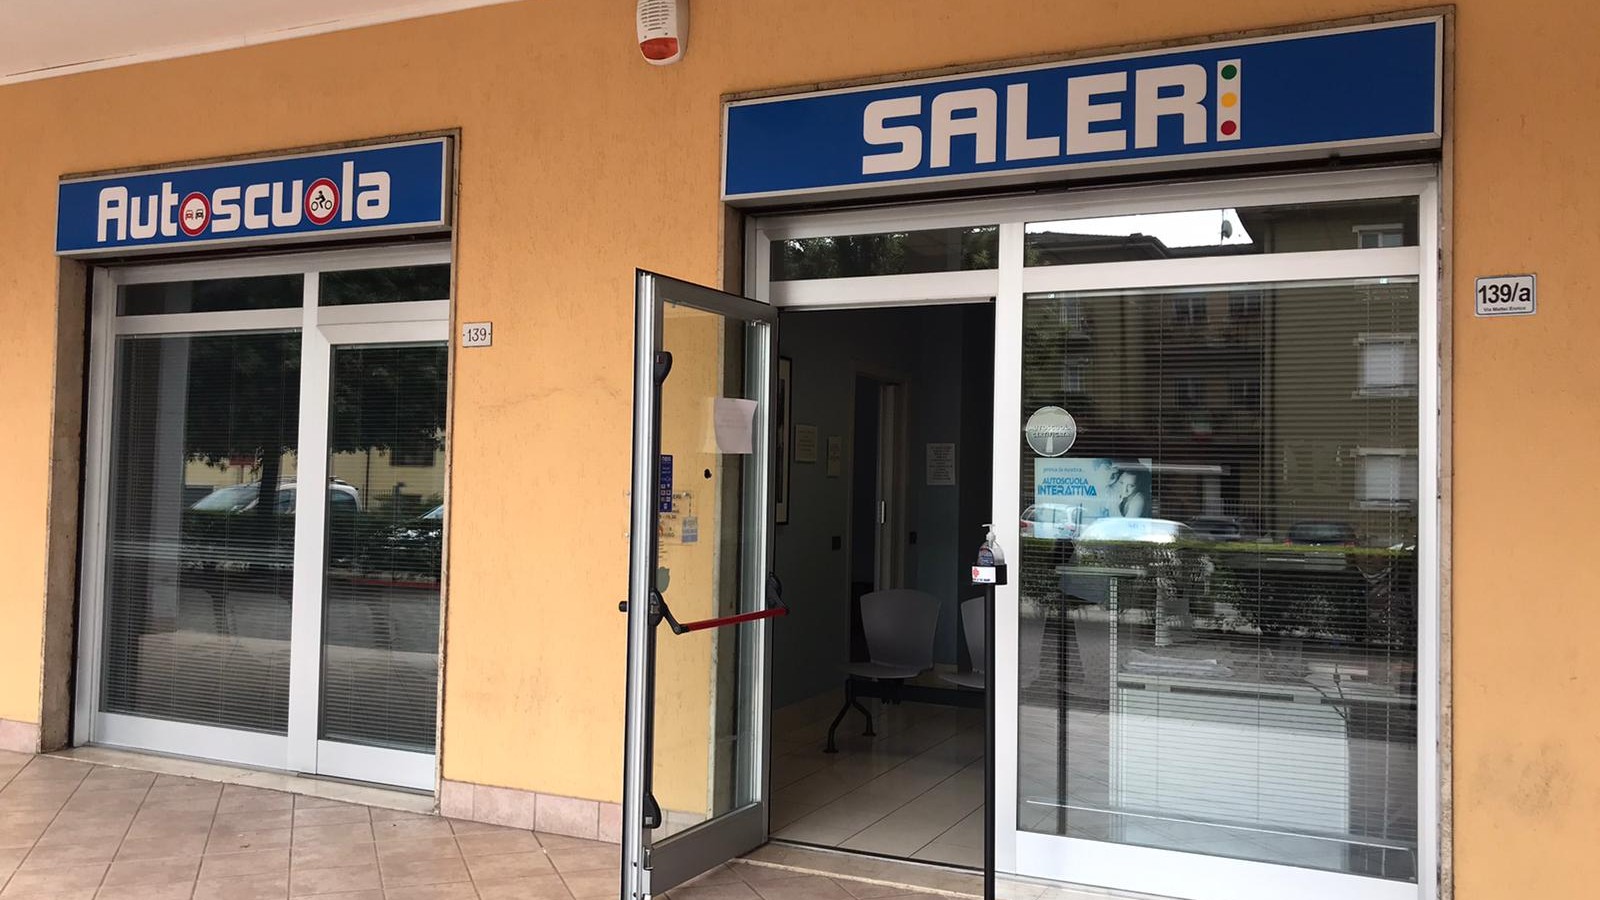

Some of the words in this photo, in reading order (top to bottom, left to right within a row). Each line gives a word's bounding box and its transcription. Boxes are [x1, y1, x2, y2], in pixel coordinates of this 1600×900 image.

[862, 58, 1241, 175] SALERI
[97, 160, 391, 243] Autoscuola
[1478, 282, 1531, 304] 139/a
[1037, 485, 1097, 496] INTERATTIVA
[1042, 477, 1089, 485] AUTOSCUOLA
